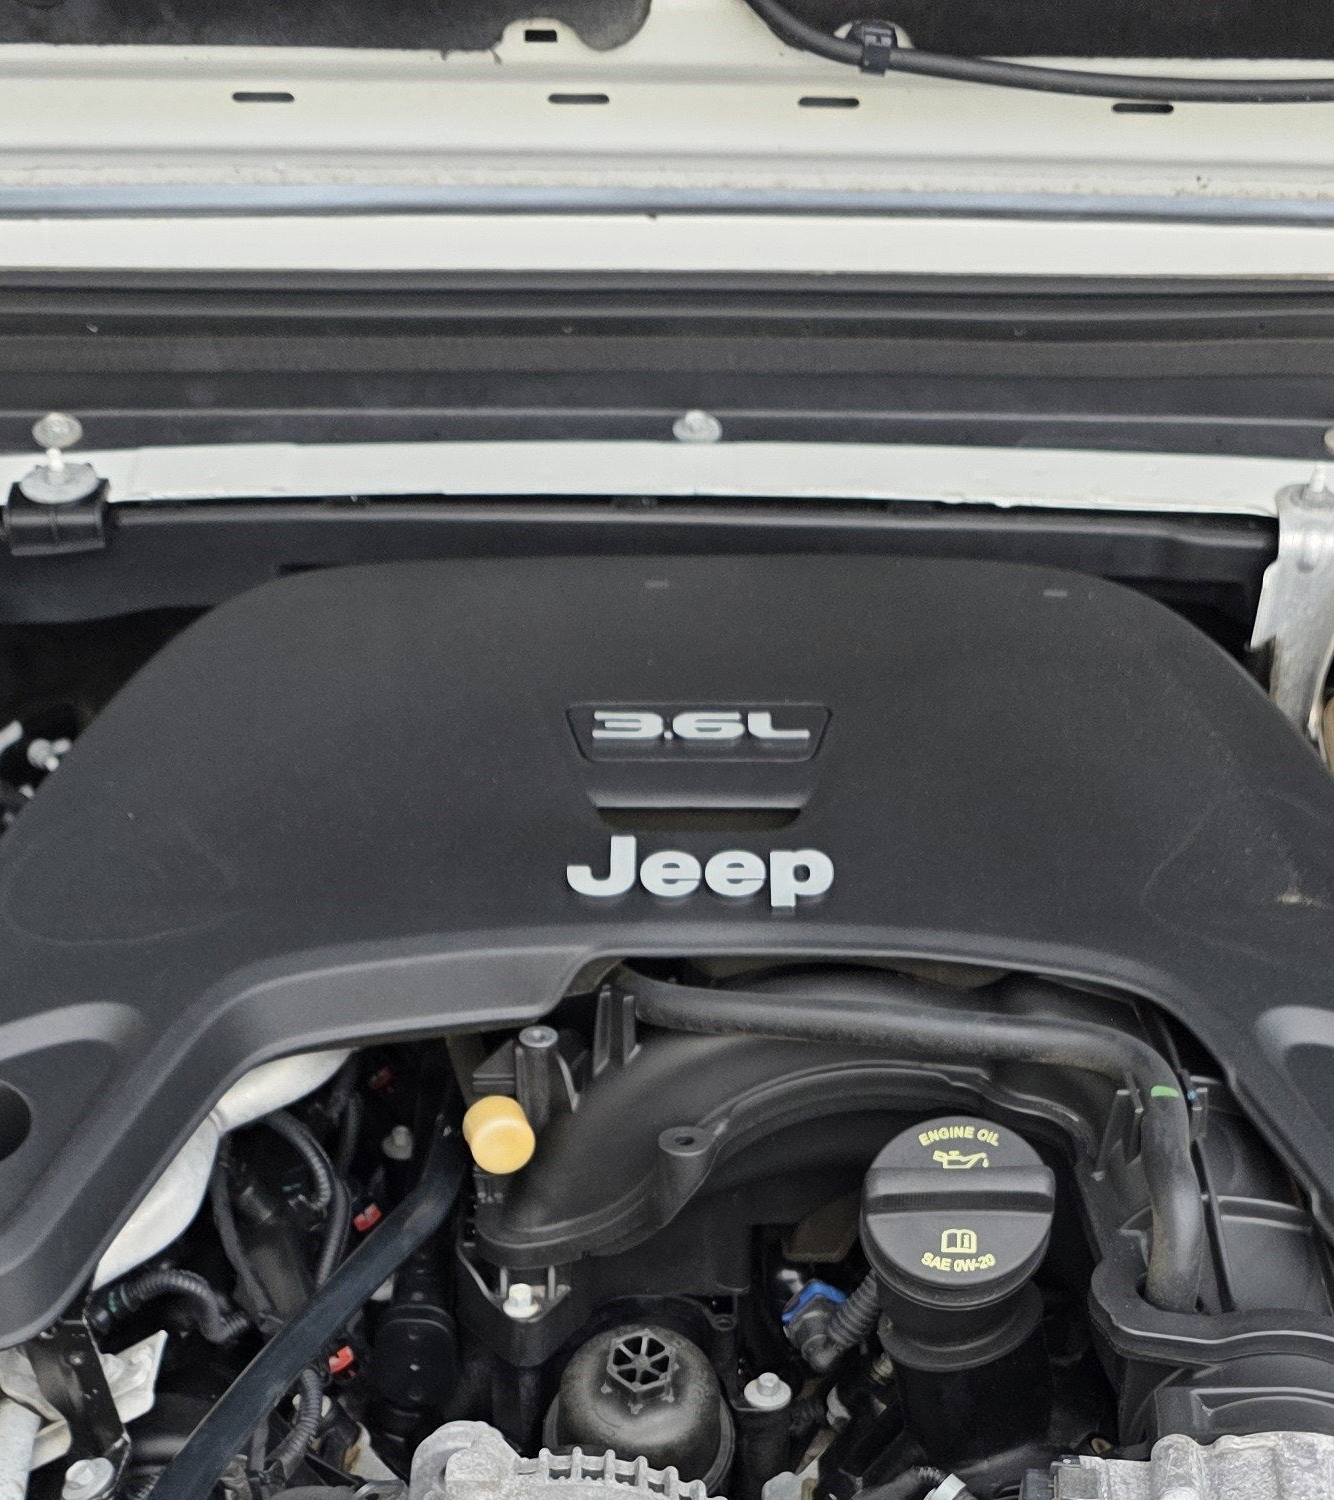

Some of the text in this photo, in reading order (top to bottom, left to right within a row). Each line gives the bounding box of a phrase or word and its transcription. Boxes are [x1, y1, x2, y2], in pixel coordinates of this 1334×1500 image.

[592, 711, 811, 740] 3.6L
[566, 835, 835, 907] Jeep
[918, 1126, 999, 1146] ENGINE OIL
[921, 1252, 996, 1272] SAE 0W-20
